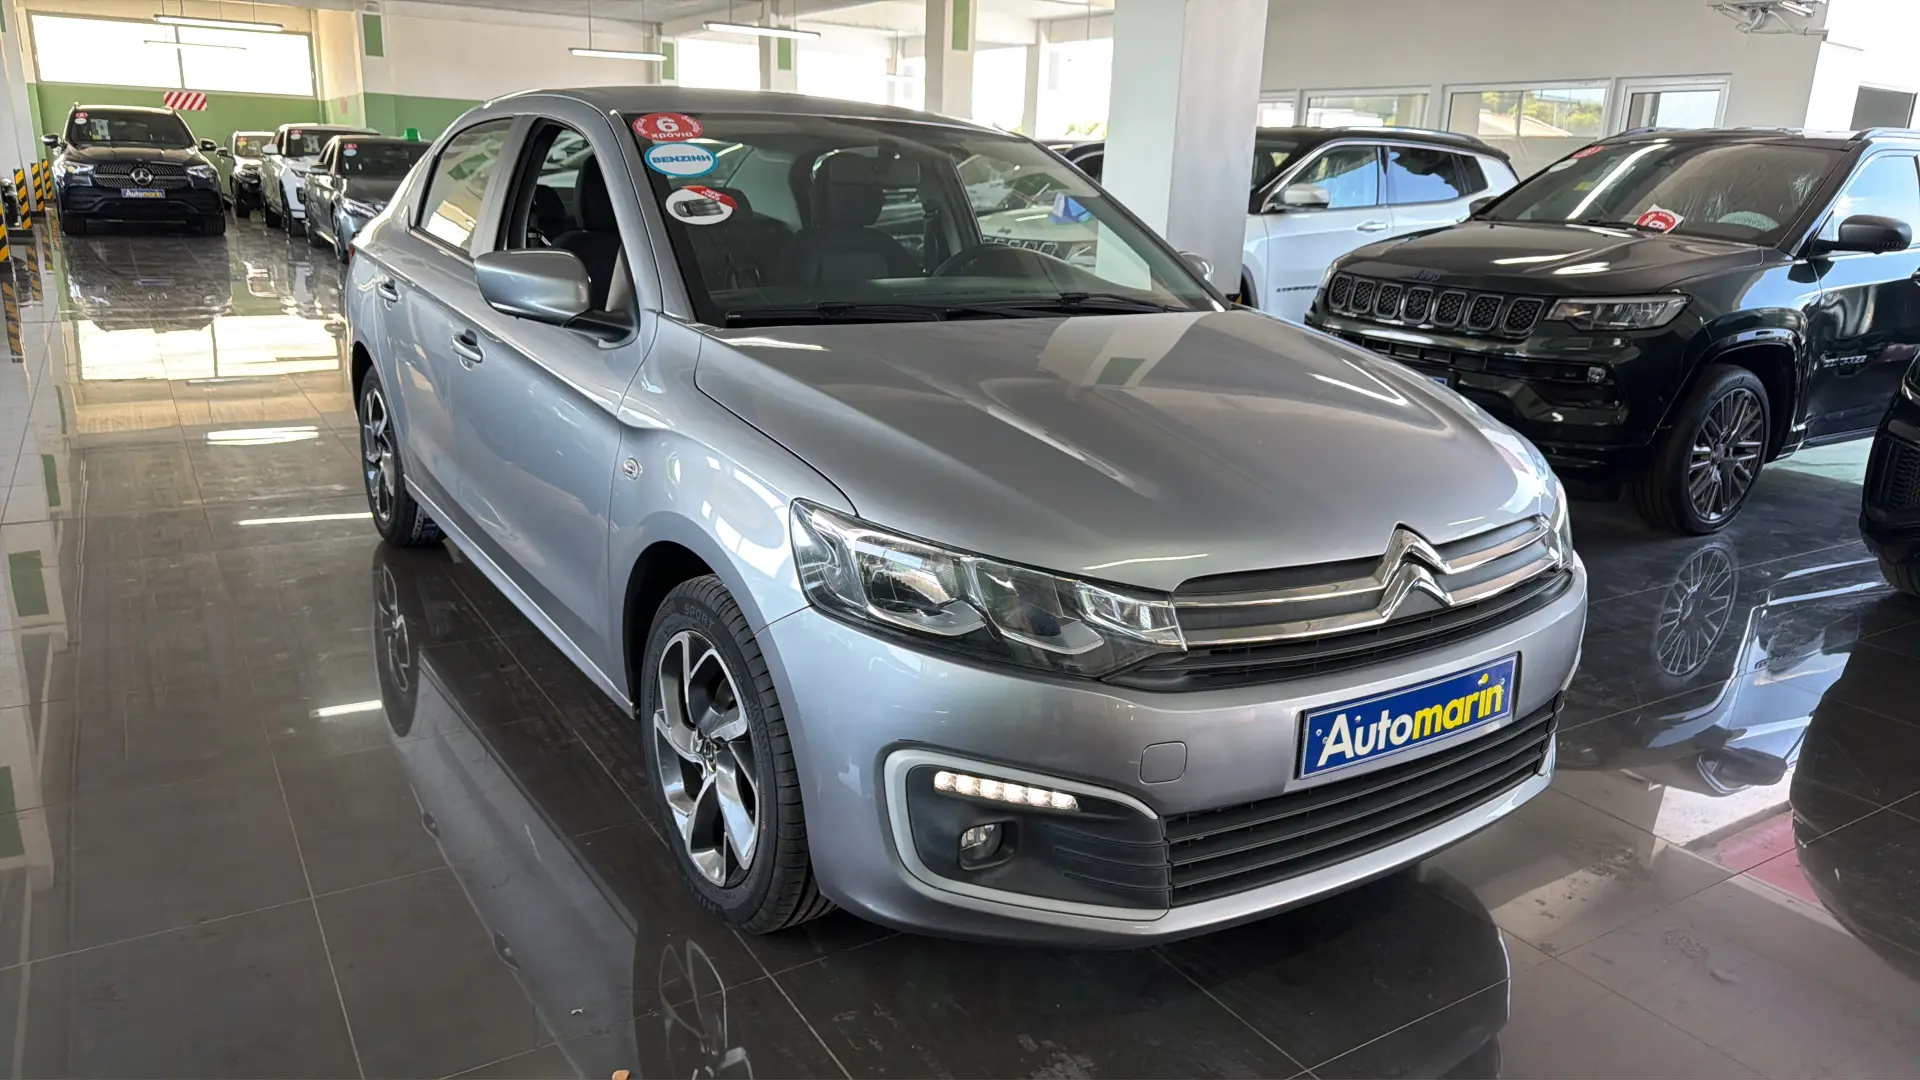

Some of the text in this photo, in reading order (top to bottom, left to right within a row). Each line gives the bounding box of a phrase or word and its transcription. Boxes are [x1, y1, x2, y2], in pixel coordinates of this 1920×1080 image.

[656, 118, 679, 132] 6
[125, 189, 163, 198] Automarin
[684, 603, 715, 630] SPORT
[1316, 672, 1504, 758] Automarin
